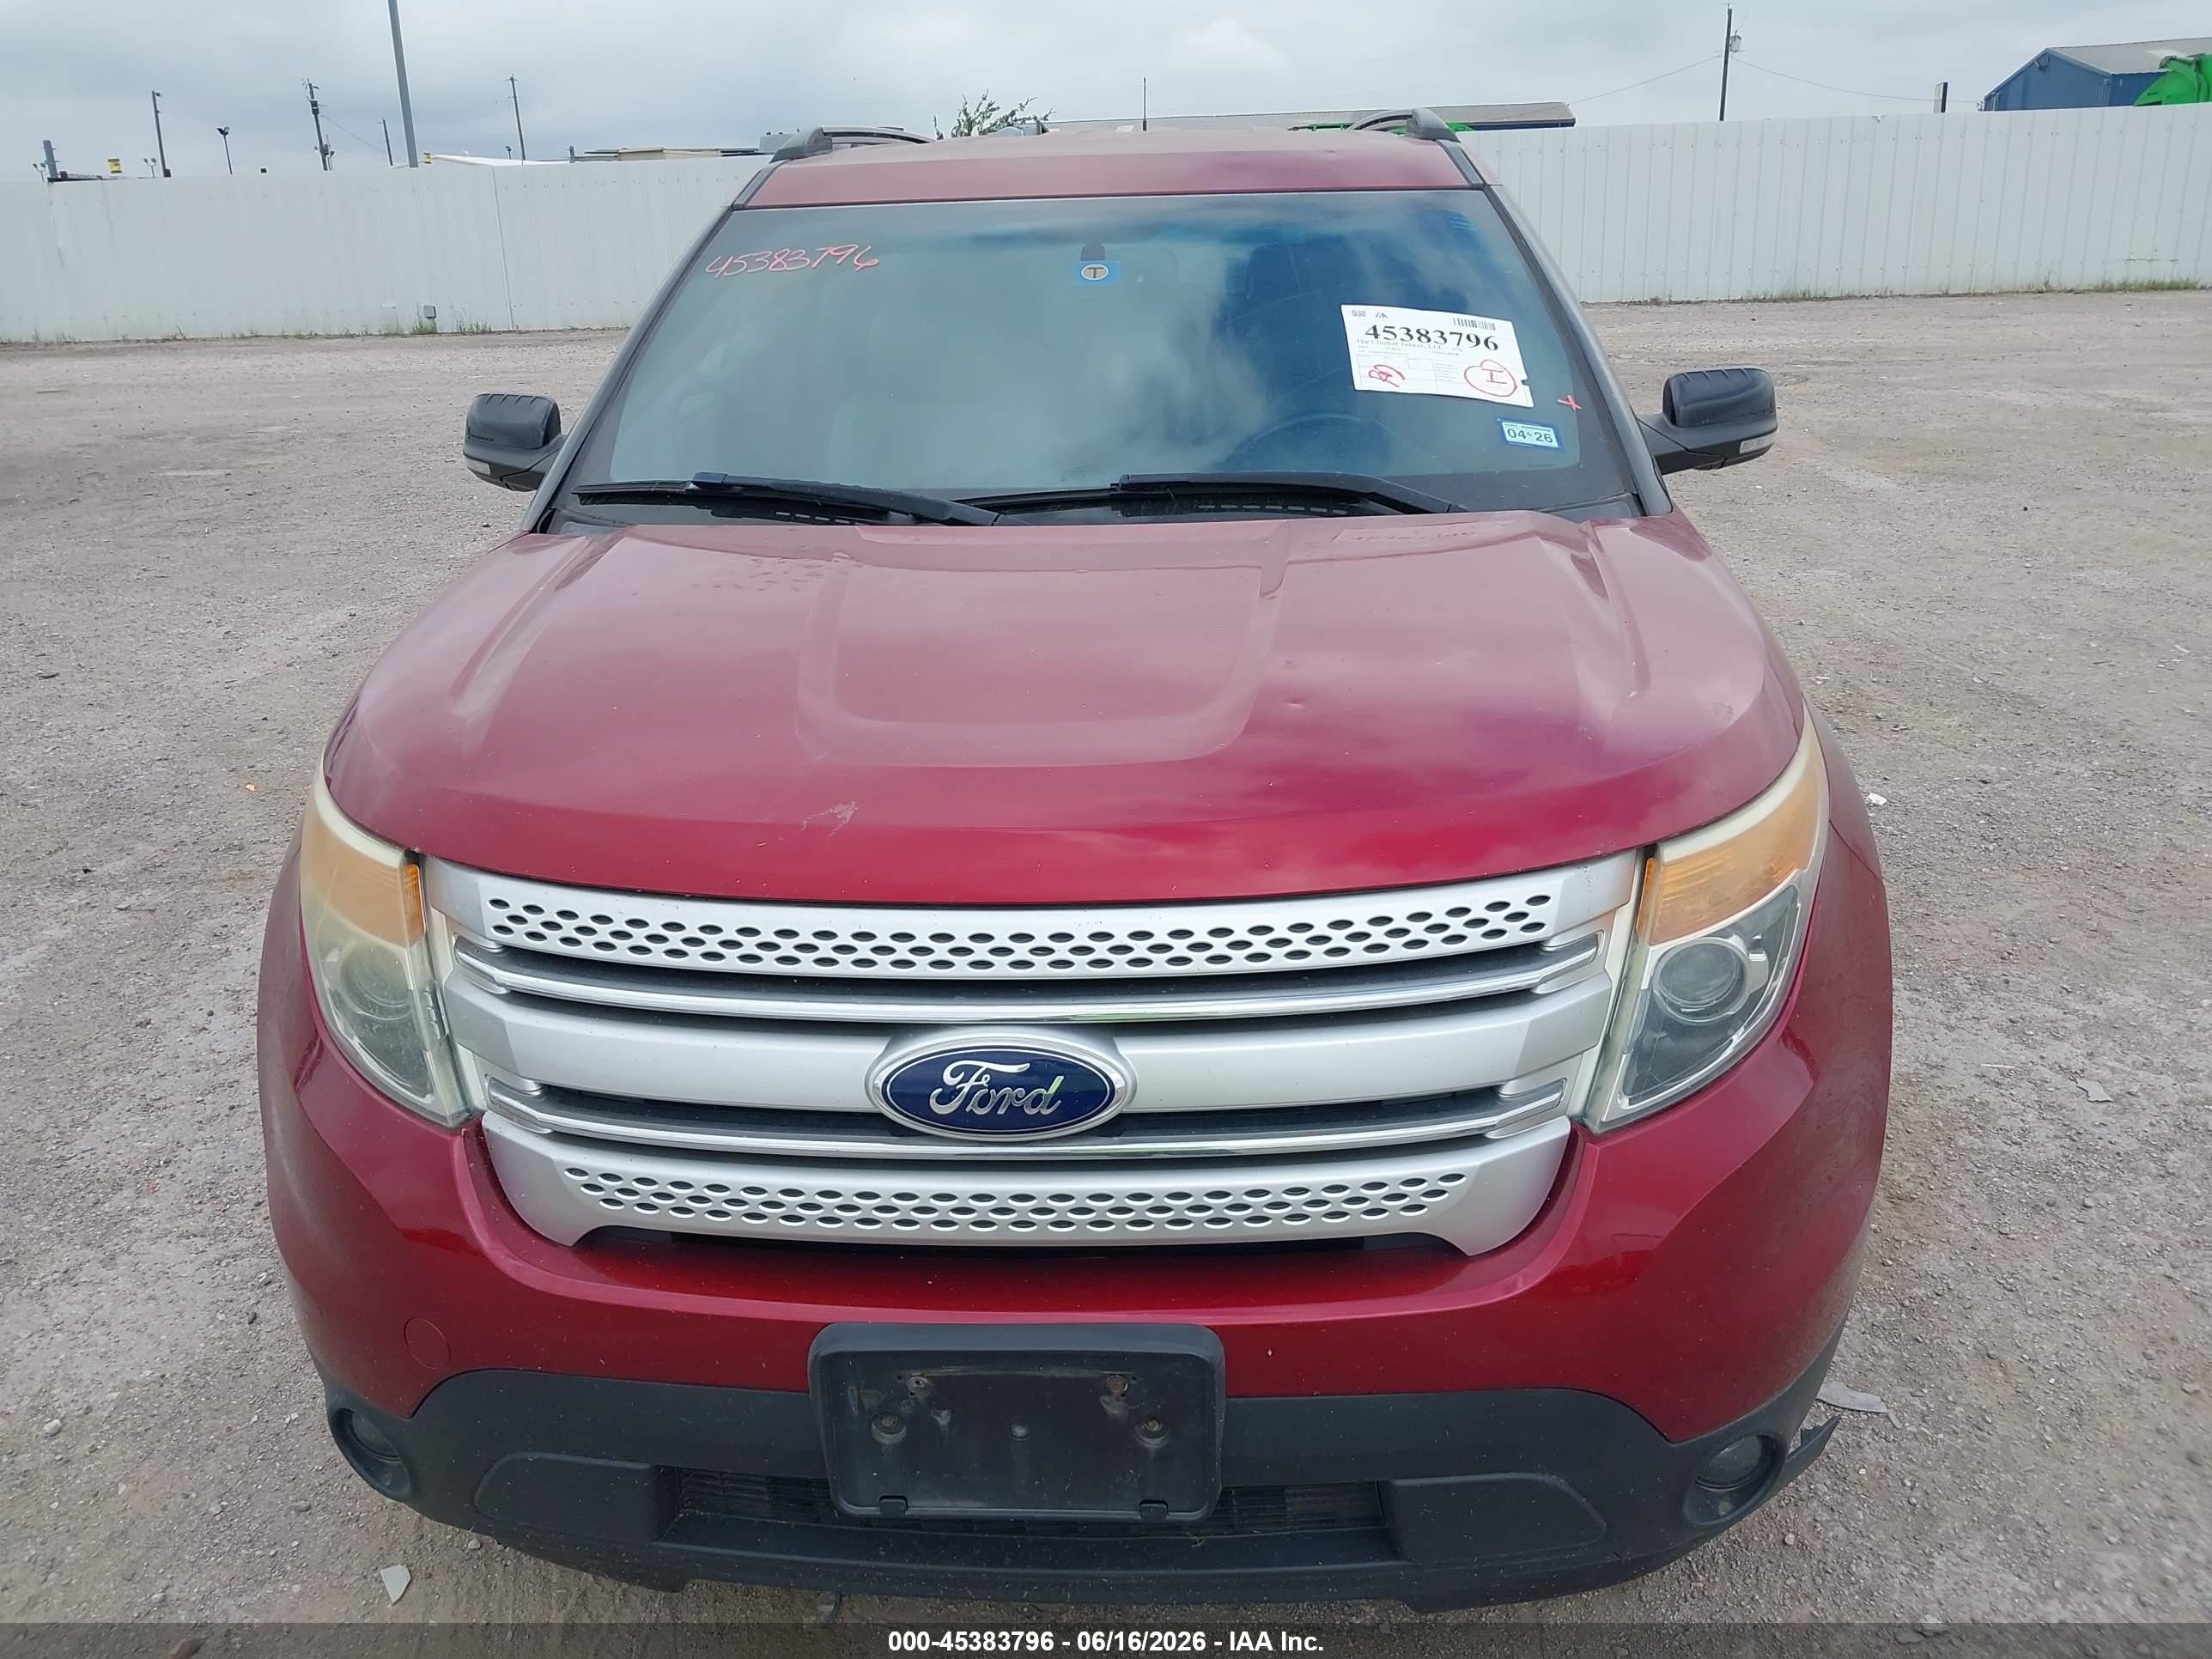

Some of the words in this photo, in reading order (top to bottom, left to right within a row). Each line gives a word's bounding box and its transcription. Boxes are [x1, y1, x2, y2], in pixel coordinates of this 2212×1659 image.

[705, 243, 879, 279] 45383796
[1364, 324, 1499, 351] 45383796
[928, 1060, 1065, 1115] Ford
